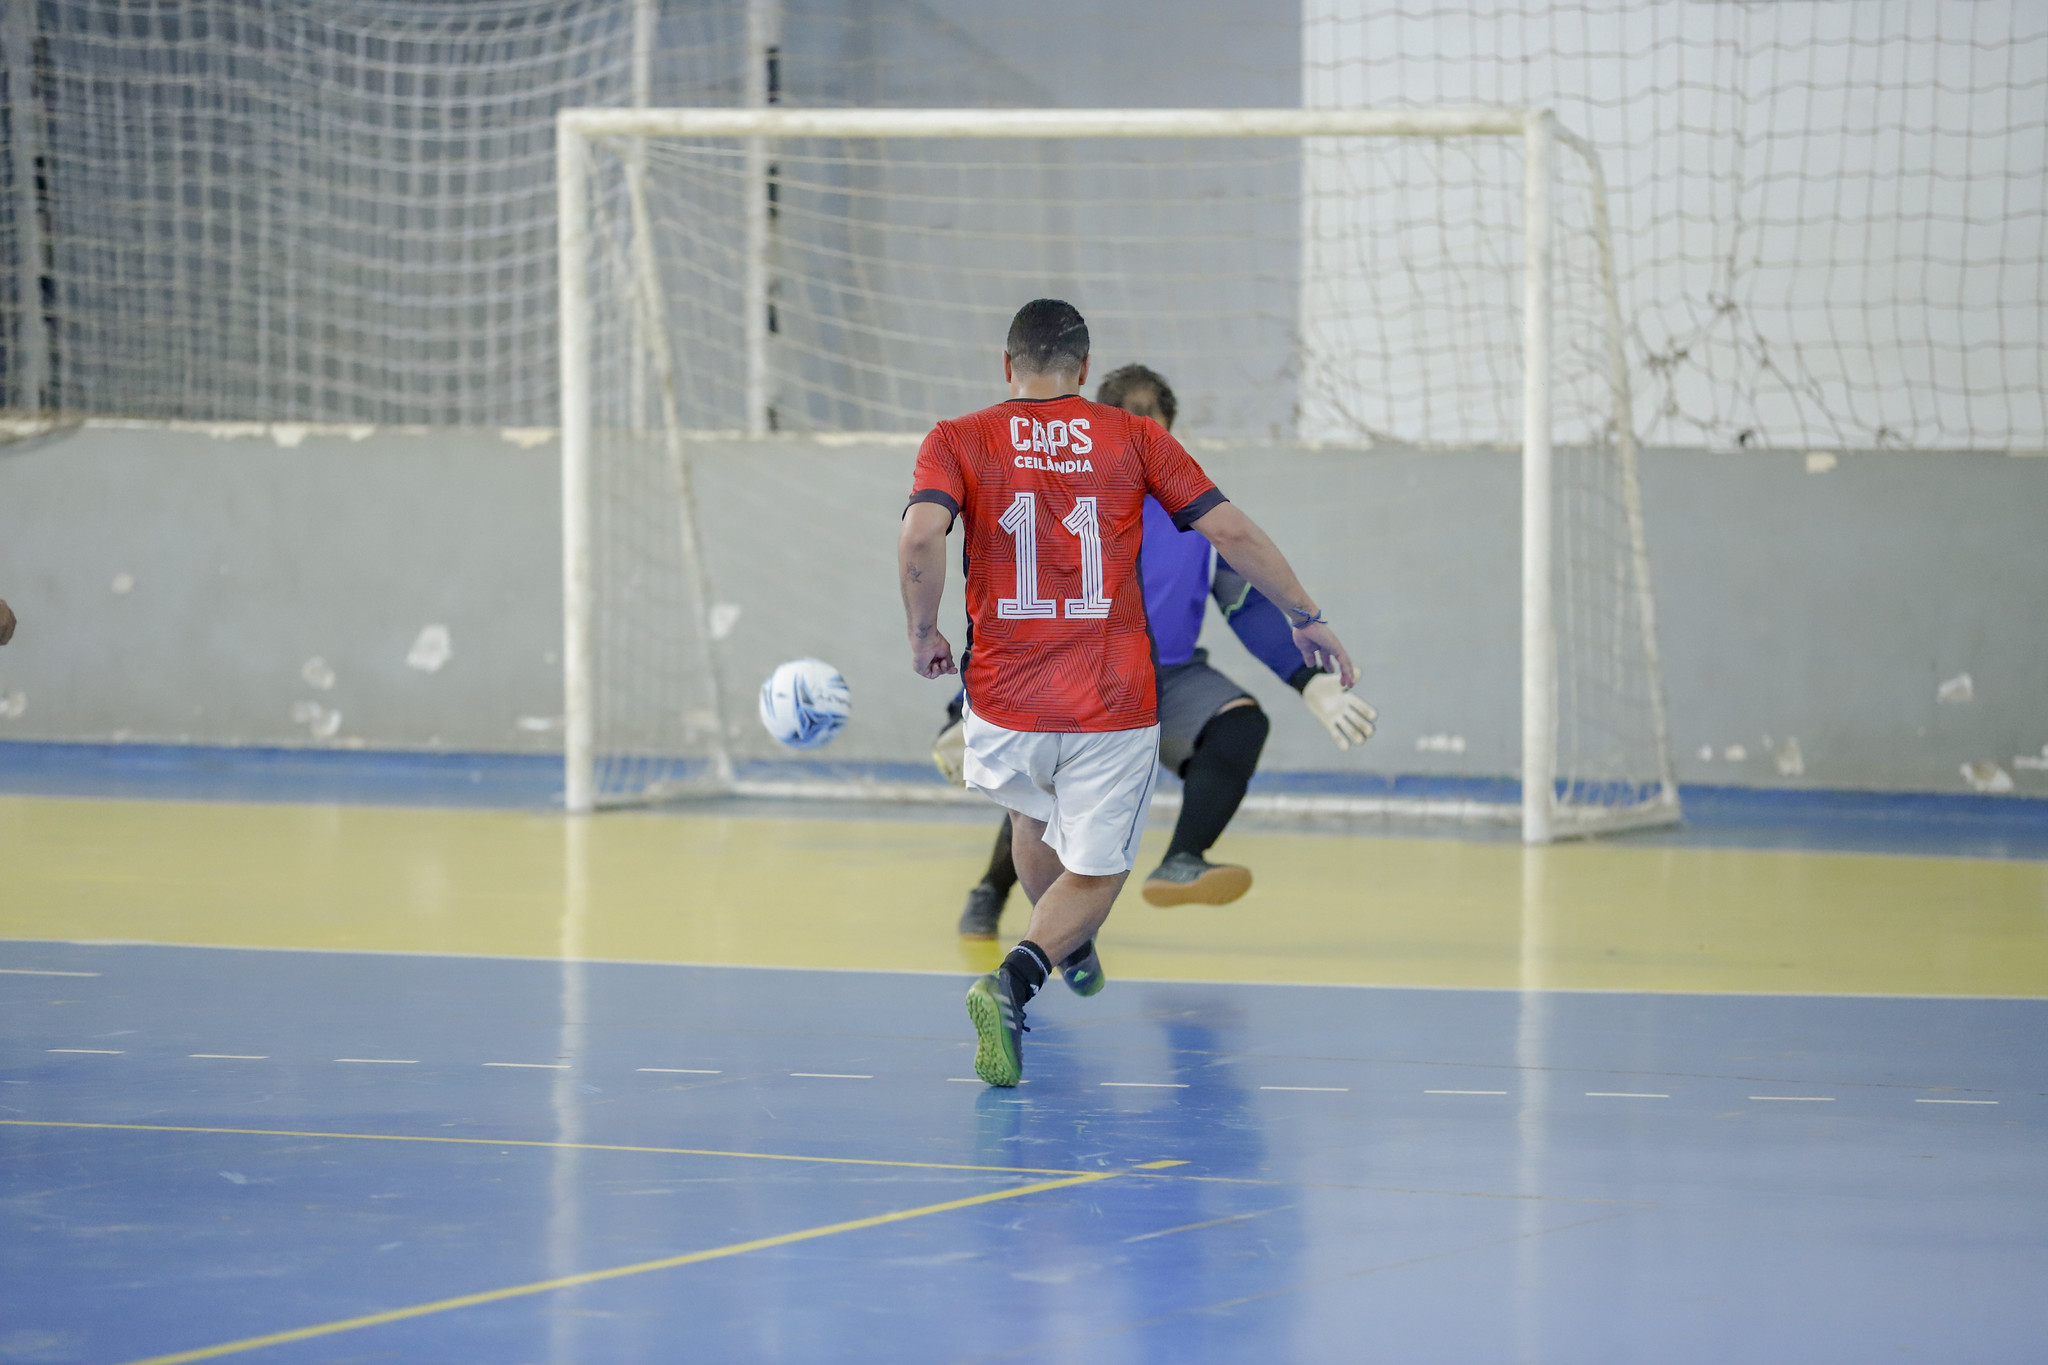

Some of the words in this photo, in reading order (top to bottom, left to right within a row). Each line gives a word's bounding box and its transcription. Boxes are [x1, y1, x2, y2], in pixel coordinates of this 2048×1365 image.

[1010, 416, 1093, 456] CAPS
[1014, 455, 1093, 473] CEILÂNDIA
[997, 492, 1113, 619] 11
